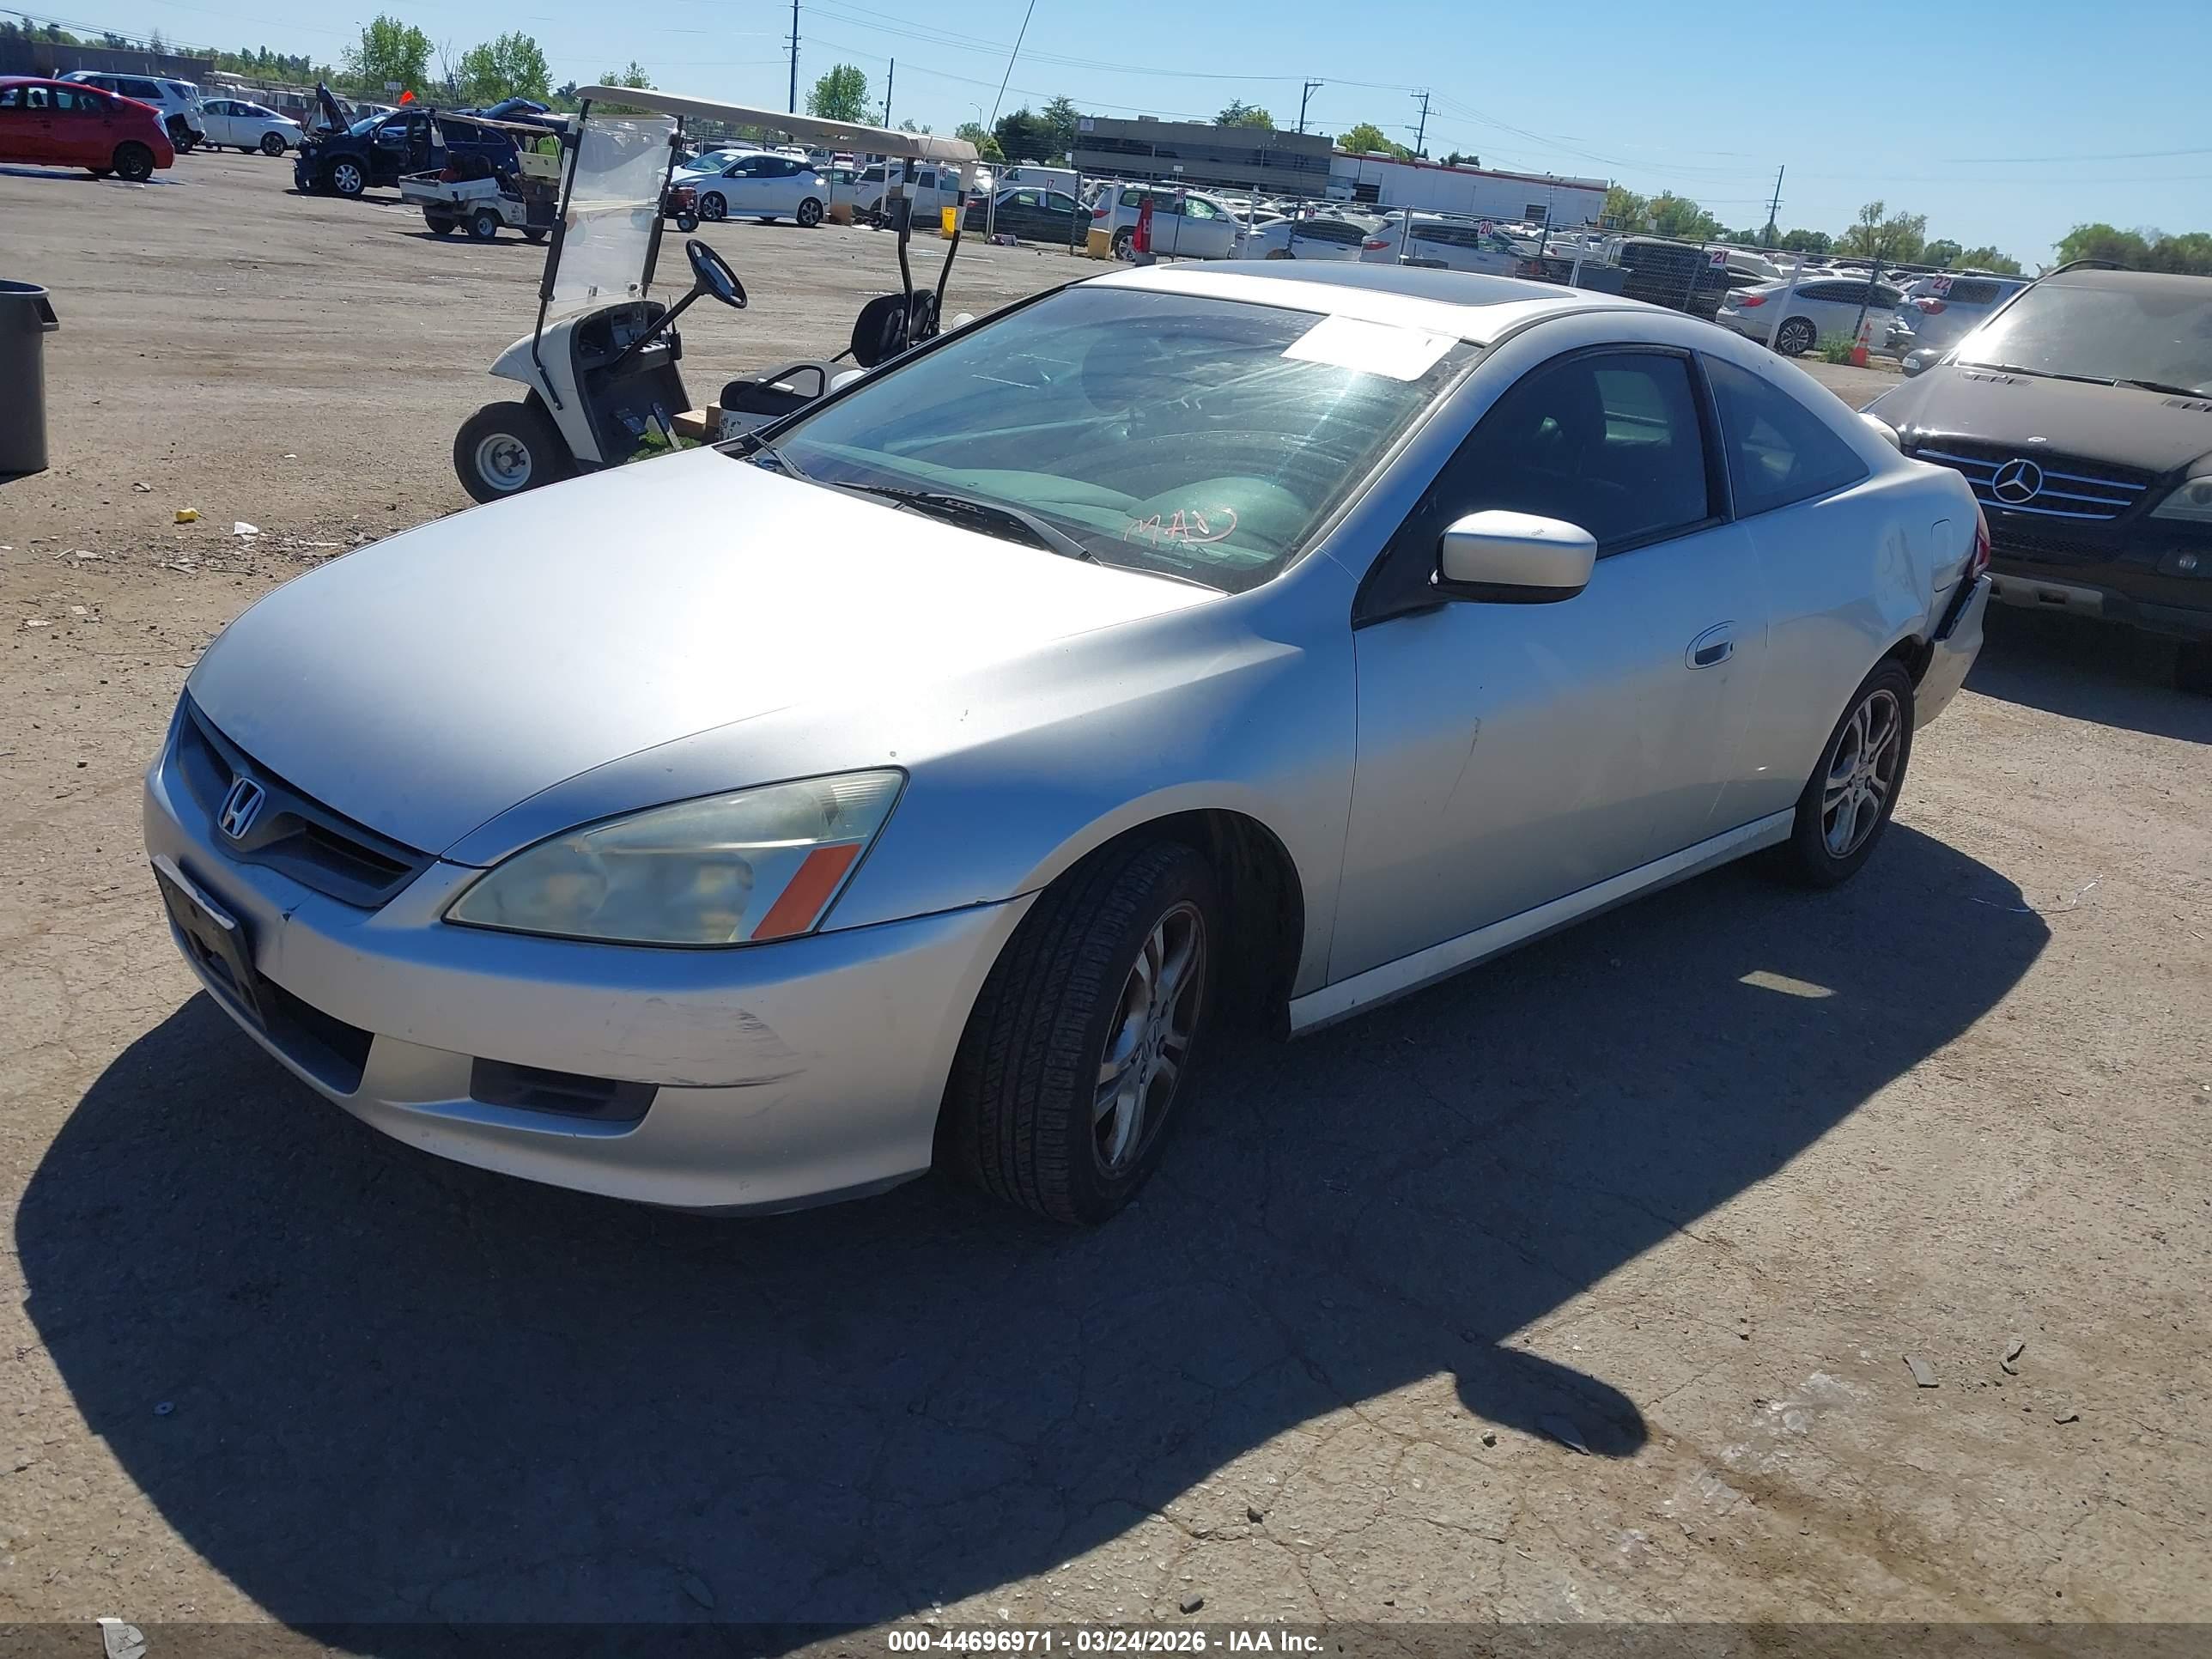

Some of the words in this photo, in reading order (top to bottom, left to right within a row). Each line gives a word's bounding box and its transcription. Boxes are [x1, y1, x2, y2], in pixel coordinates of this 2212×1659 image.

[1046, 178, 1055, 189] 17
[1304, 206, 1316, 218] 19
[1480, 222, 1492, 234] 20
[1711, 250, 1729, 264] 21
[1933, 275, 1952, 290] 22
